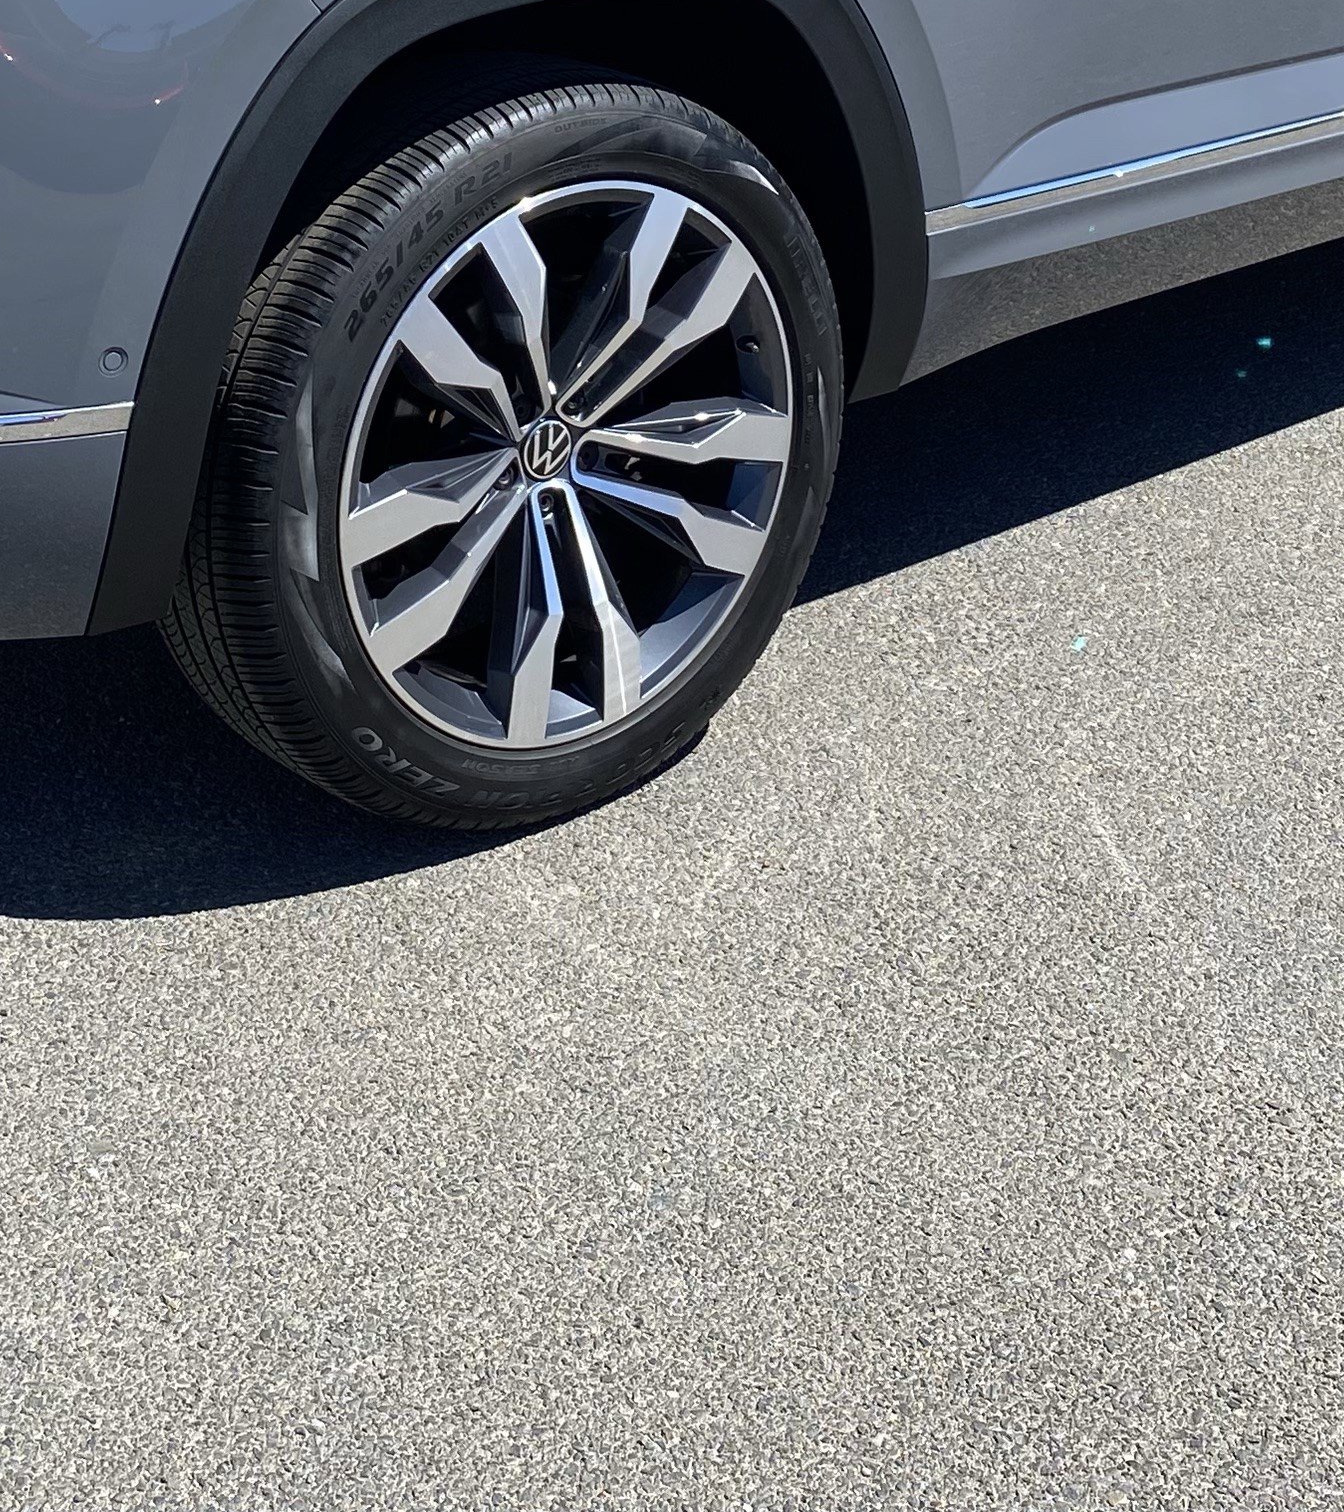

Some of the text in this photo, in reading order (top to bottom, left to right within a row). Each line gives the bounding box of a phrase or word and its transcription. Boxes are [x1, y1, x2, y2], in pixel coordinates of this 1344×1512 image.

[344, 200, 444, 341] 265/45
[454, 152, 513, 206] R21
[353, 726, 461, 799] ZERO
